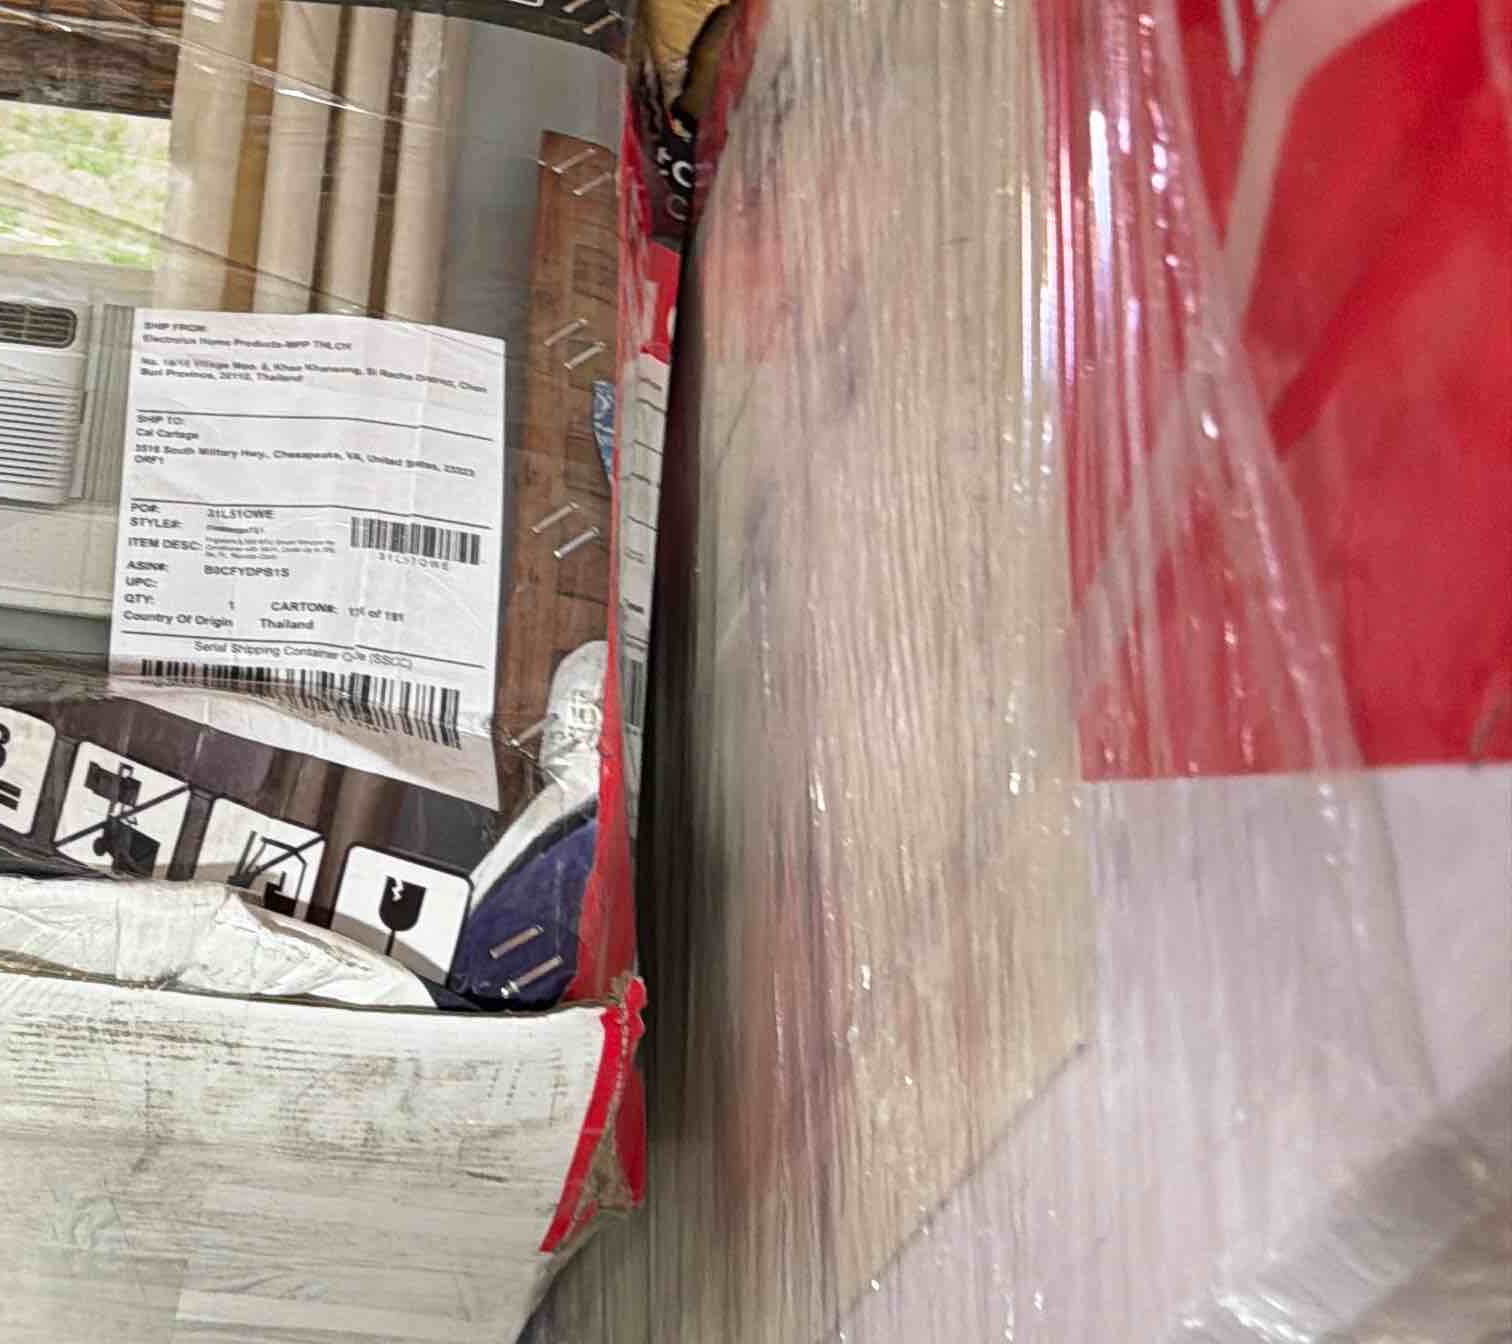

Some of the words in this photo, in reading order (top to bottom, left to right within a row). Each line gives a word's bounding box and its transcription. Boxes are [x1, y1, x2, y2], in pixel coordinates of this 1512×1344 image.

[127, 537, 160, 548] ITEM
[162, 540, 203, 551] DESC:
[125, 576, 159, 588] UPC:
[123, 593, 156, 605] QTY:
[123, 610, 174, 625] Country
[194, 615, 234, 629] Origin
[260, 618, 315, 631] Thailand
[194, 641, 227, 653] Serial
[230, 642, 280, 658] Shipping
